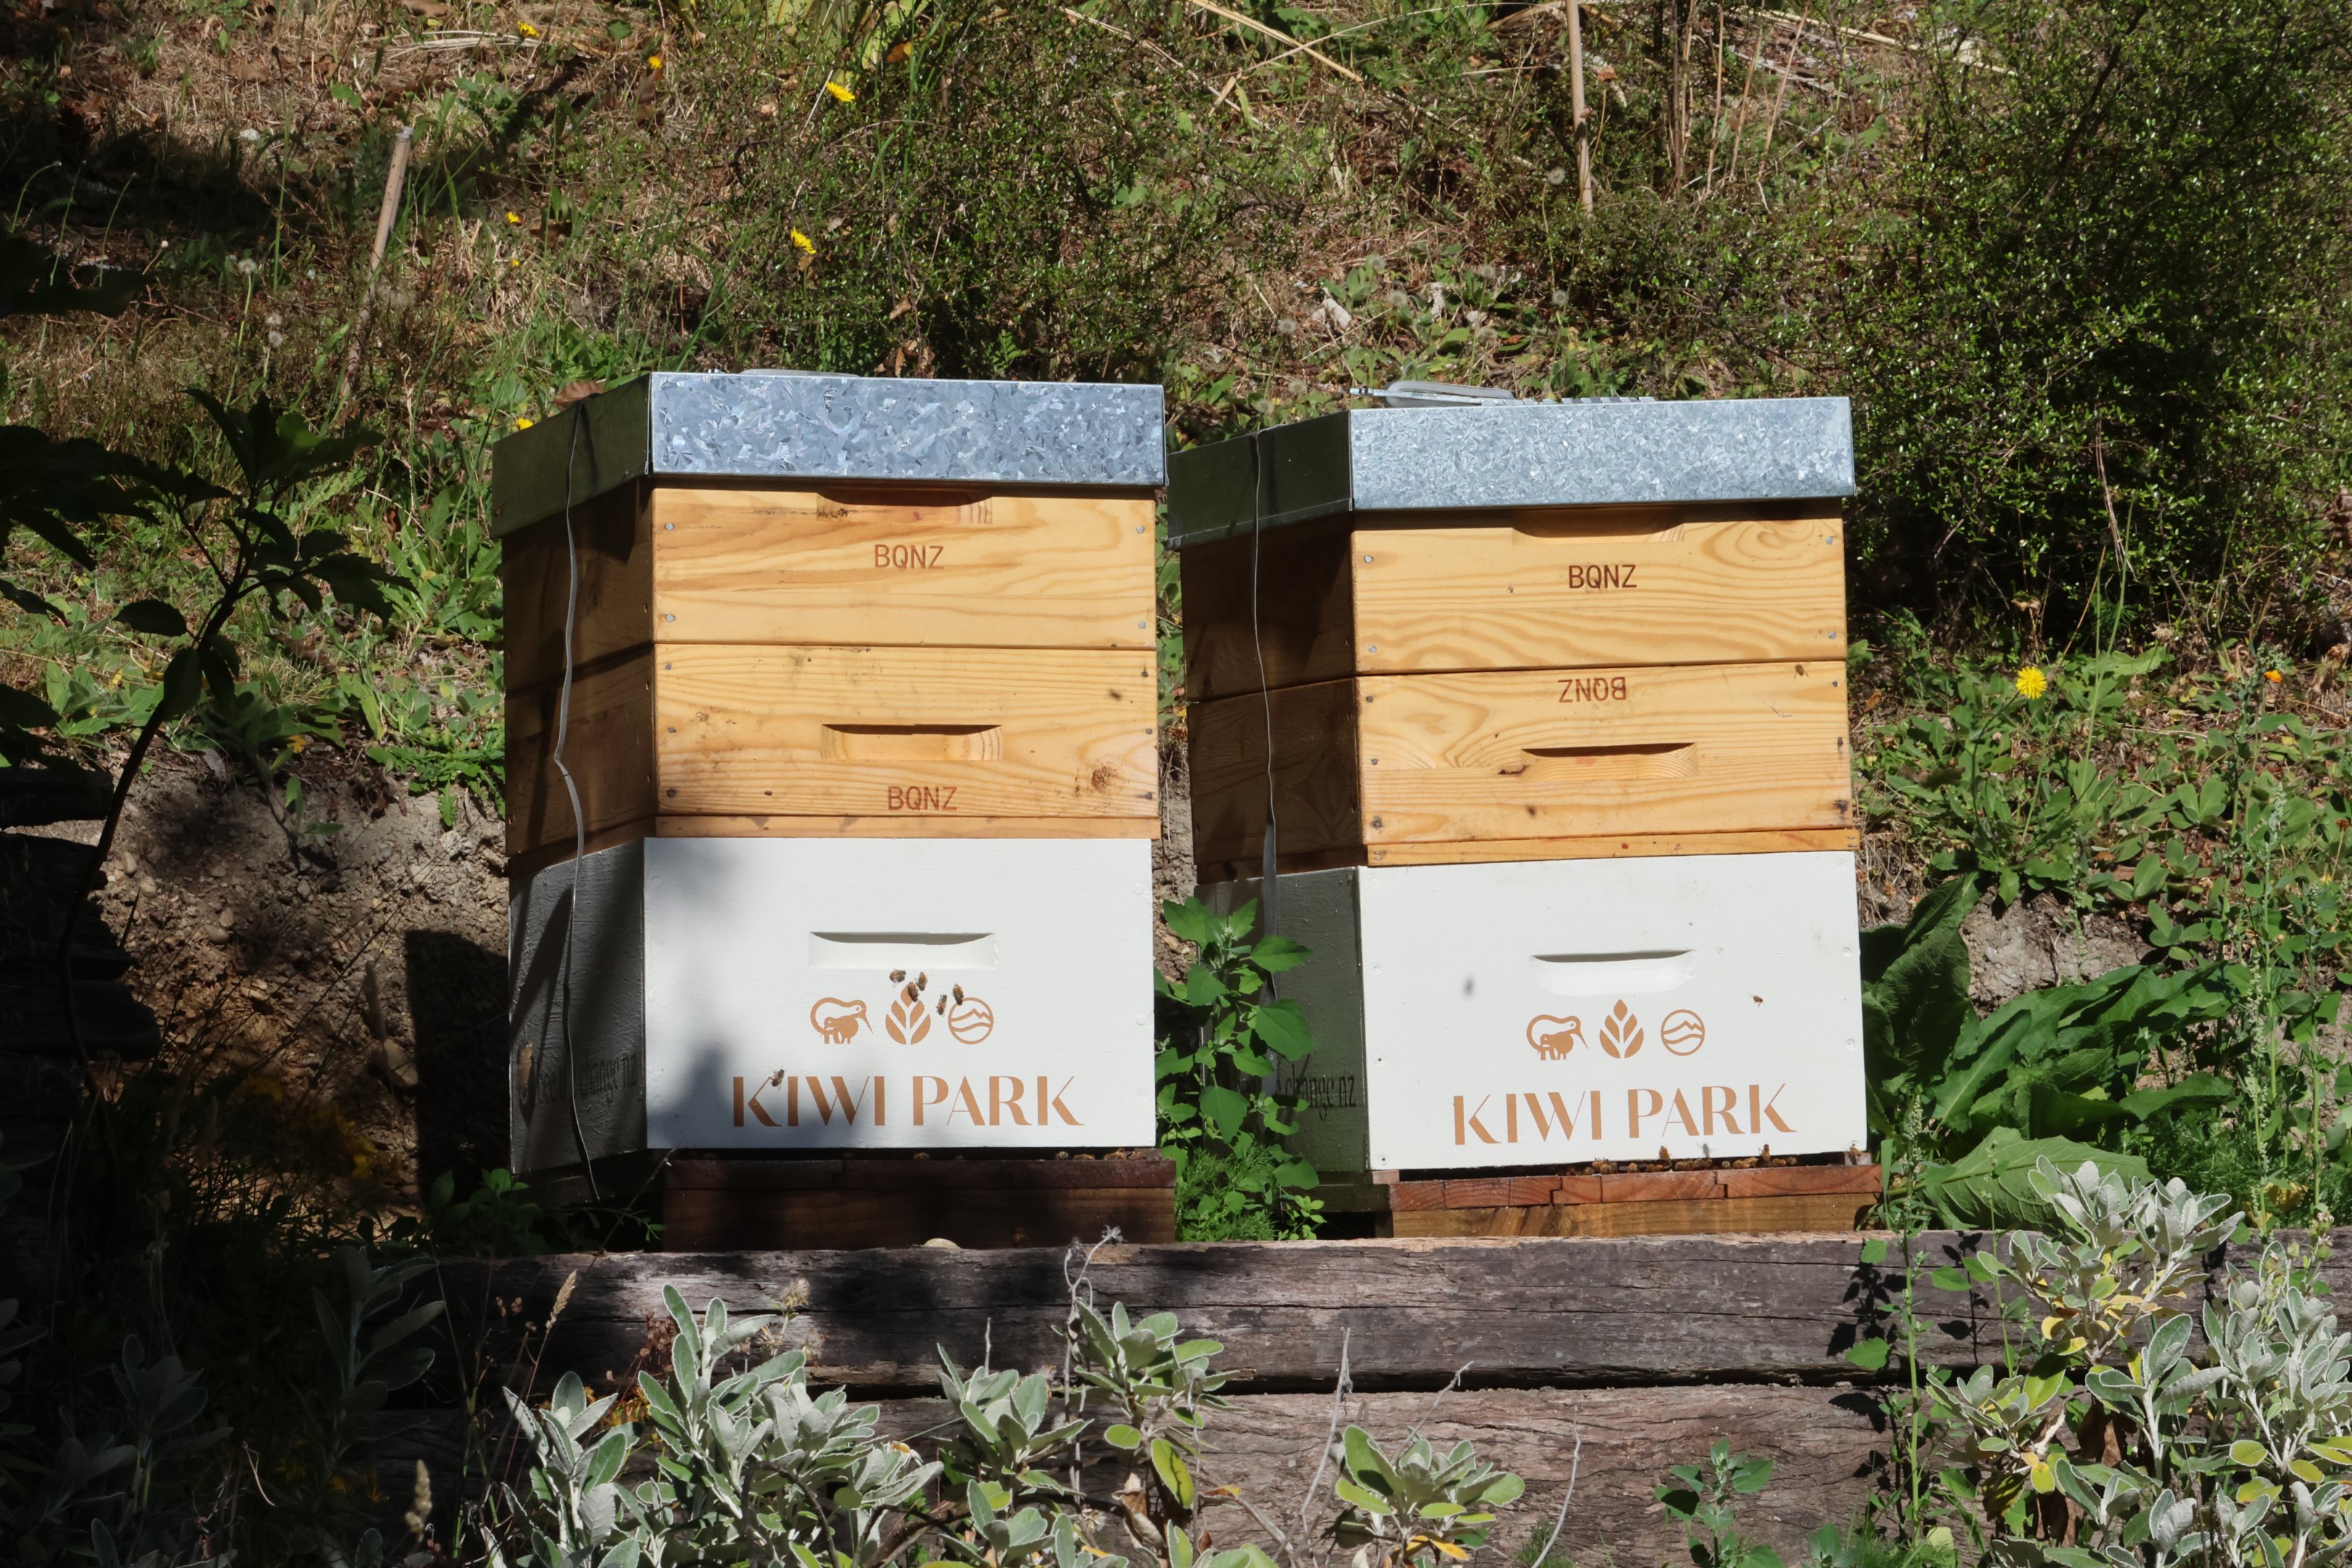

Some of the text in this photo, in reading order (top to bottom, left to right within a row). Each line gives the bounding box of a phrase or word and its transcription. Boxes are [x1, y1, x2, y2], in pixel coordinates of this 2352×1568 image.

[874, 544, 944, 569] BQNZ
[1569, 564, 1637, 589] BQNZ
[1558, 677, 1627, 702] BQNZ
[888, 785, 957, 811] BQNZ
[733, 1075, 1085, 1127] KIWI PARK
[1453, 1084, 1797, 1146] KIWI PARK
